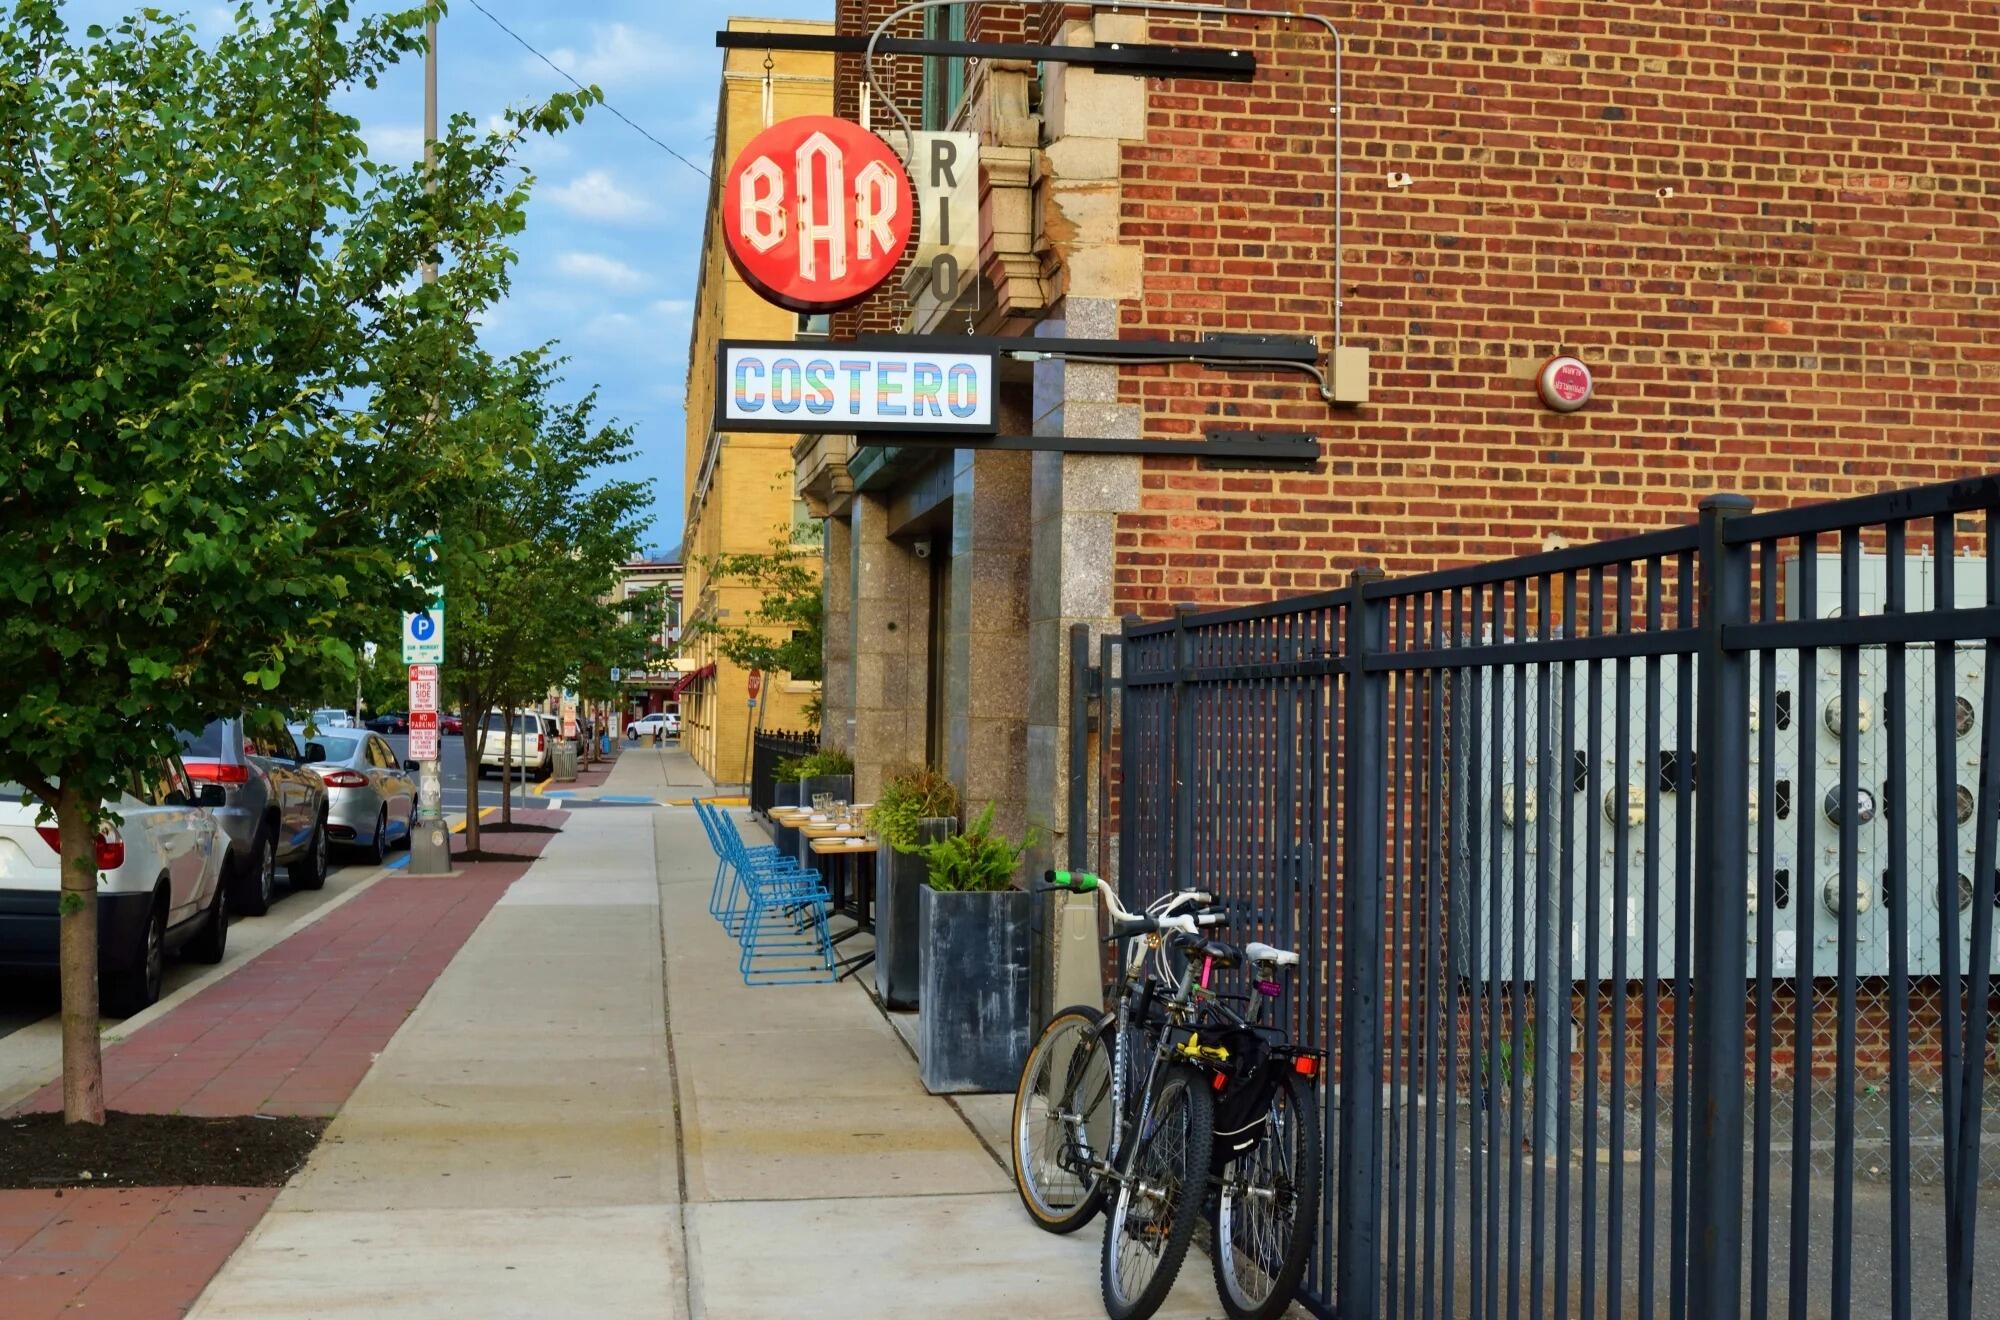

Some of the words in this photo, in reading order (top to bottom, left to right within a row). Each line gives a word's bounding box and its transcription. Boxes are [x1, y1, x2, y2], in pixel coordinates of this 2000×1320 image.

[740, 131, 898, 282] BAR
[931, 139, 959, 303] RIO
[735, 357, 977, 418] COSTERO
[418, 620, 429, 635] P
[418, 669, 436, 677] PARKING
[415, 682, 432, 690] THIS
[749, 676, 760, 689] STOP
[415, 690, 432, 698] SIDE
[411, 721, 436, 729] PARKING
